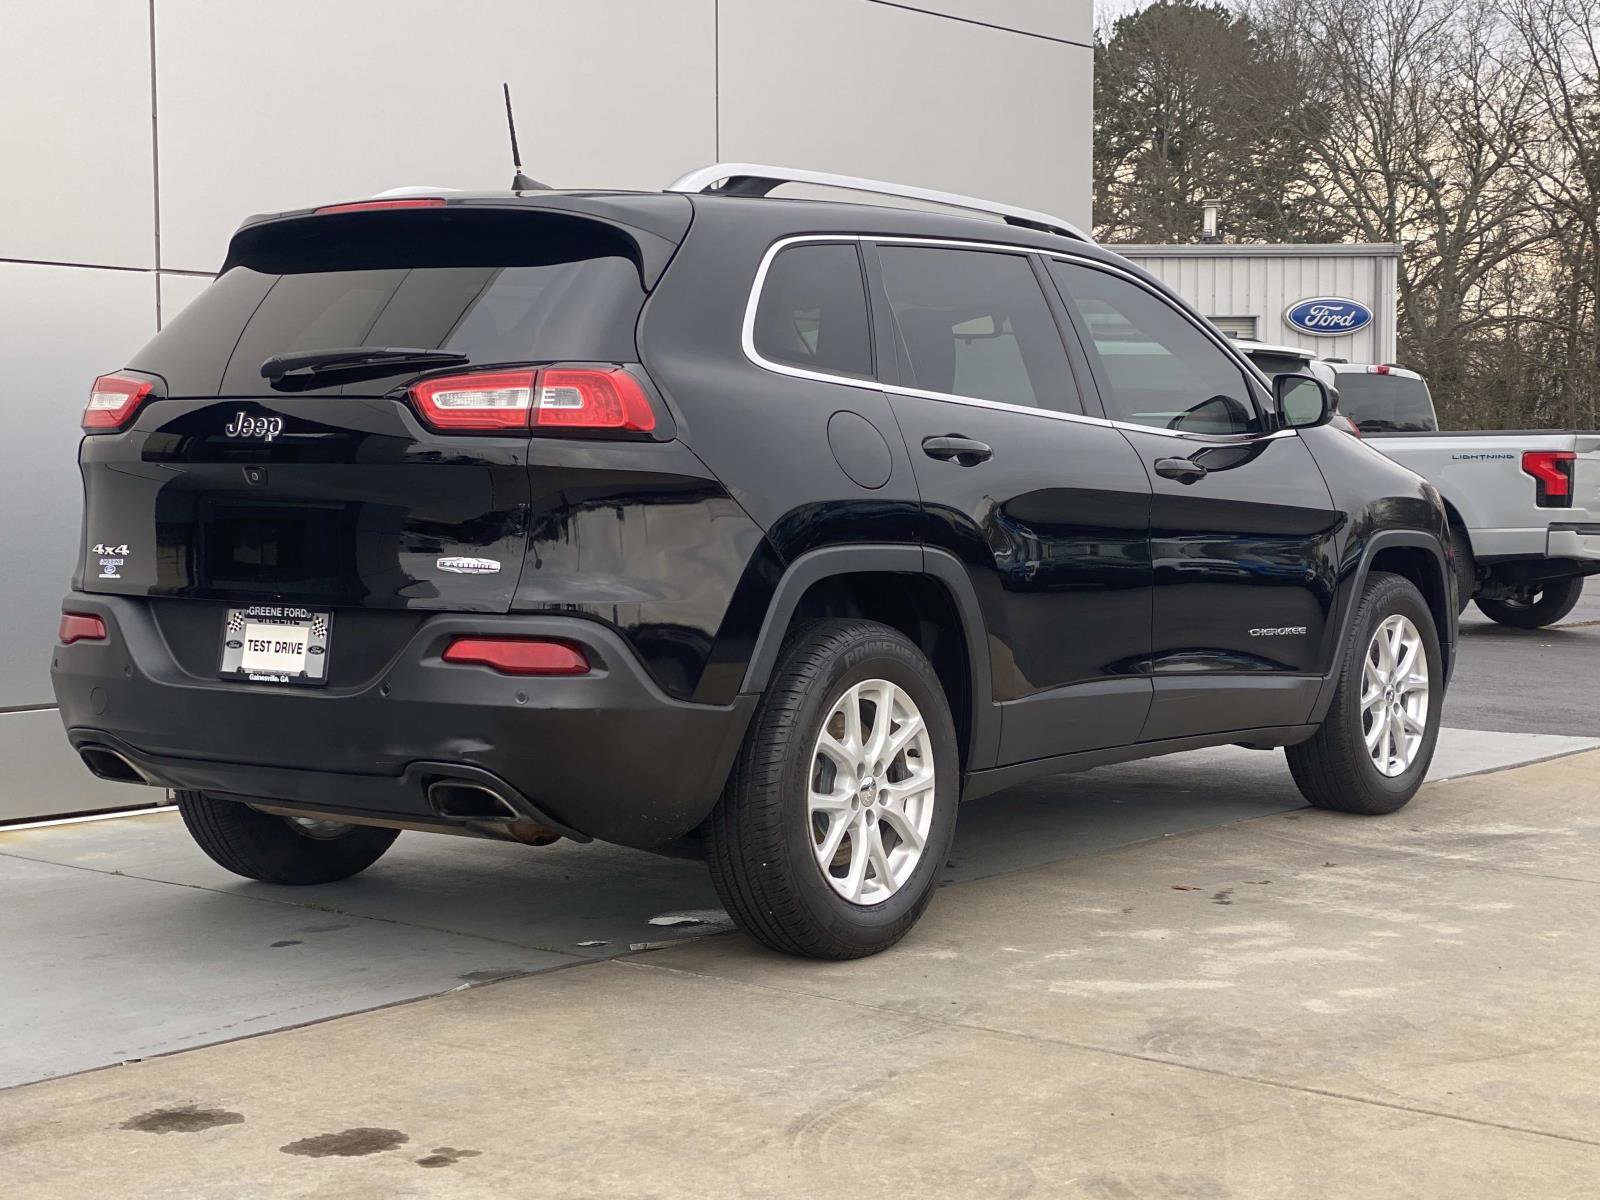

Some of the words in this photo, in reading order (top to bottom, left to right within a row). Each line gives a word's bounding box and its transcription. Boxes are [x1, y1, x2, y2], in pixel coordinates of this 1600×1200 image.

[1304, 305, 1356, 326] Ford
[225, 411, 282, 441] Jeep
[92, 543, 130, 556] 4x4
[249, 606, 282, 616] GREENE
[284, 607, 307, 618] FORD
[1248, 626, 1307, 636] CHEROKEE
[248, 640, 272, 652] TEST
[274, 641, 303, 655] DRIVE
